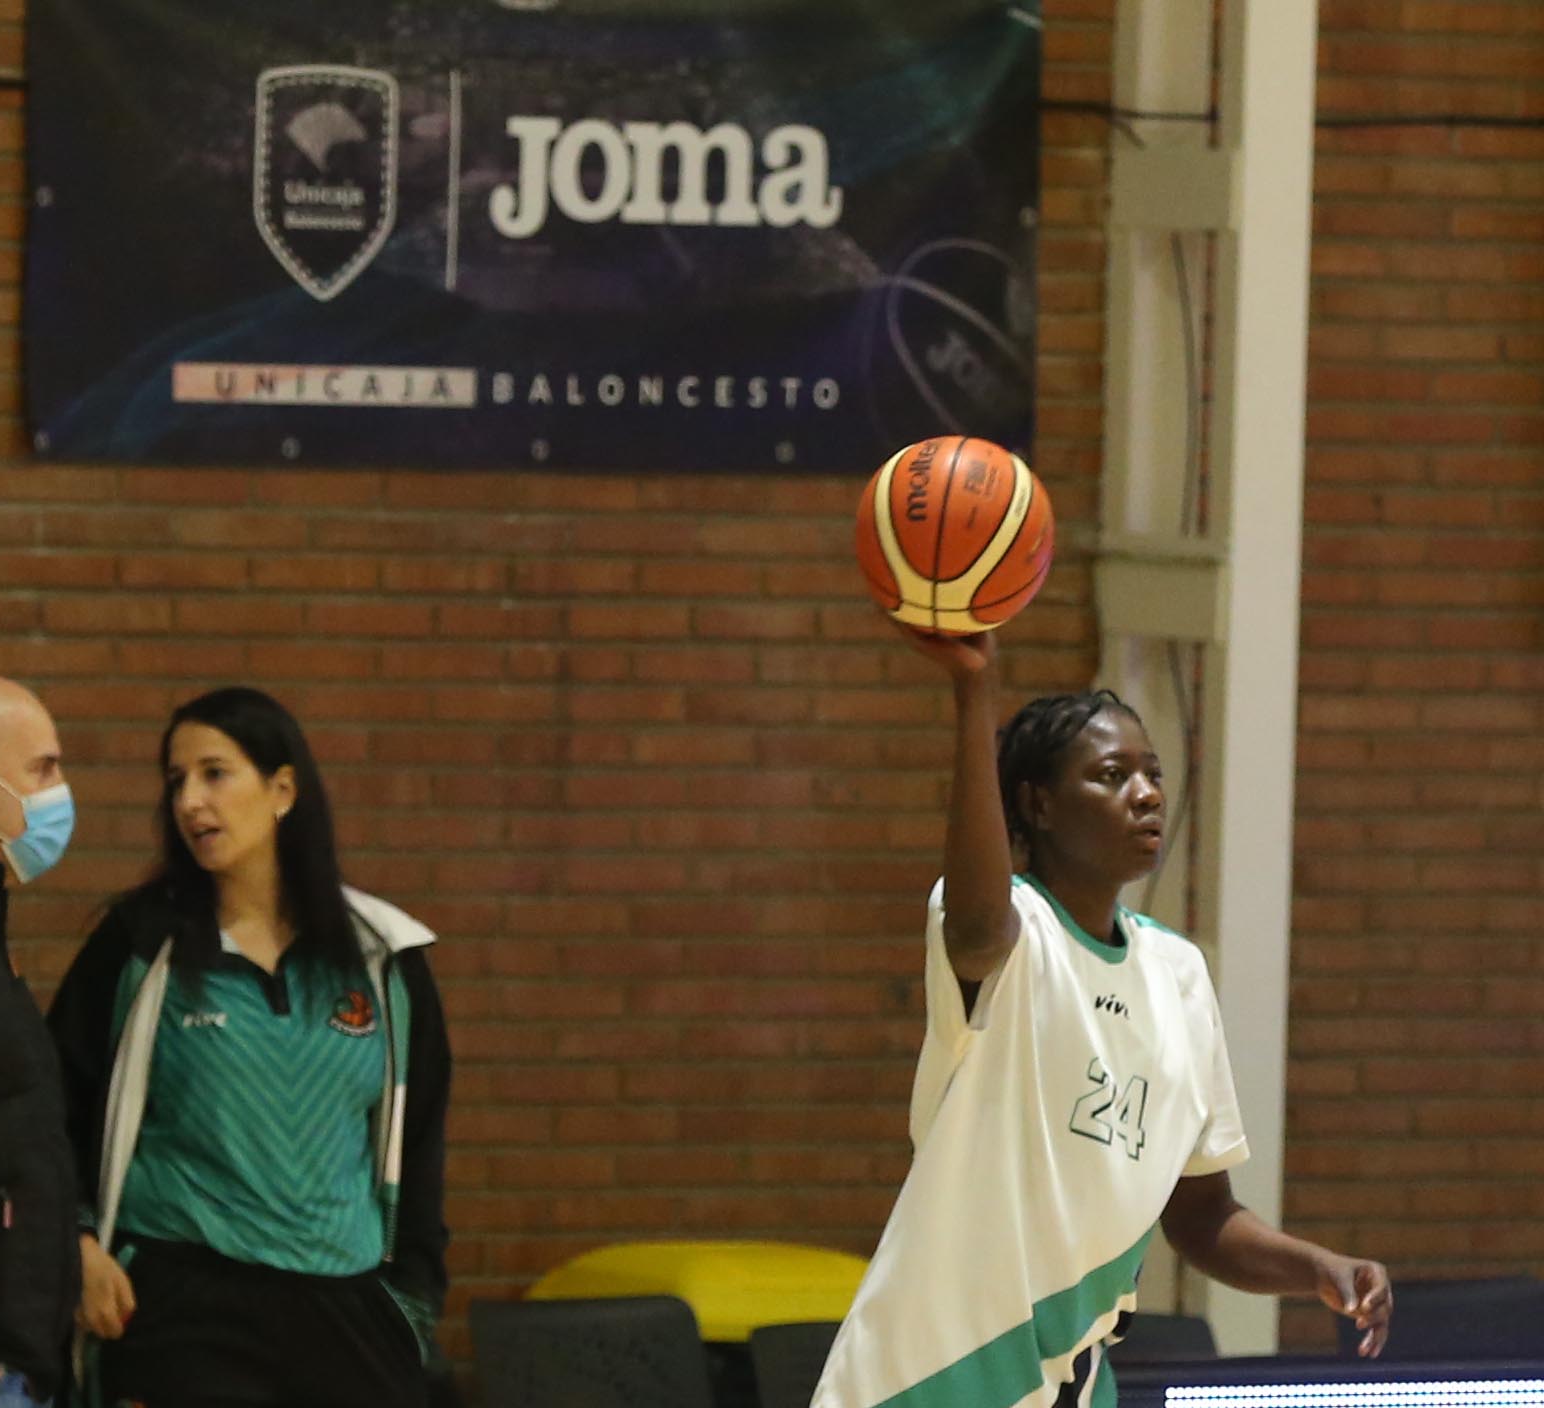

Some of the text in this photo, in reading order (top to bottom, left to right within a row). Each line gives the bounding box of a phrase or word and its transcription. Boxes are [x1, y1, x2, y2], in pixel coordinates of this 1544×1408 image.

[213, 369, 841, 410] UNICAJA BALONCESTO
[1069, 1056, 1149, 1162] 24
